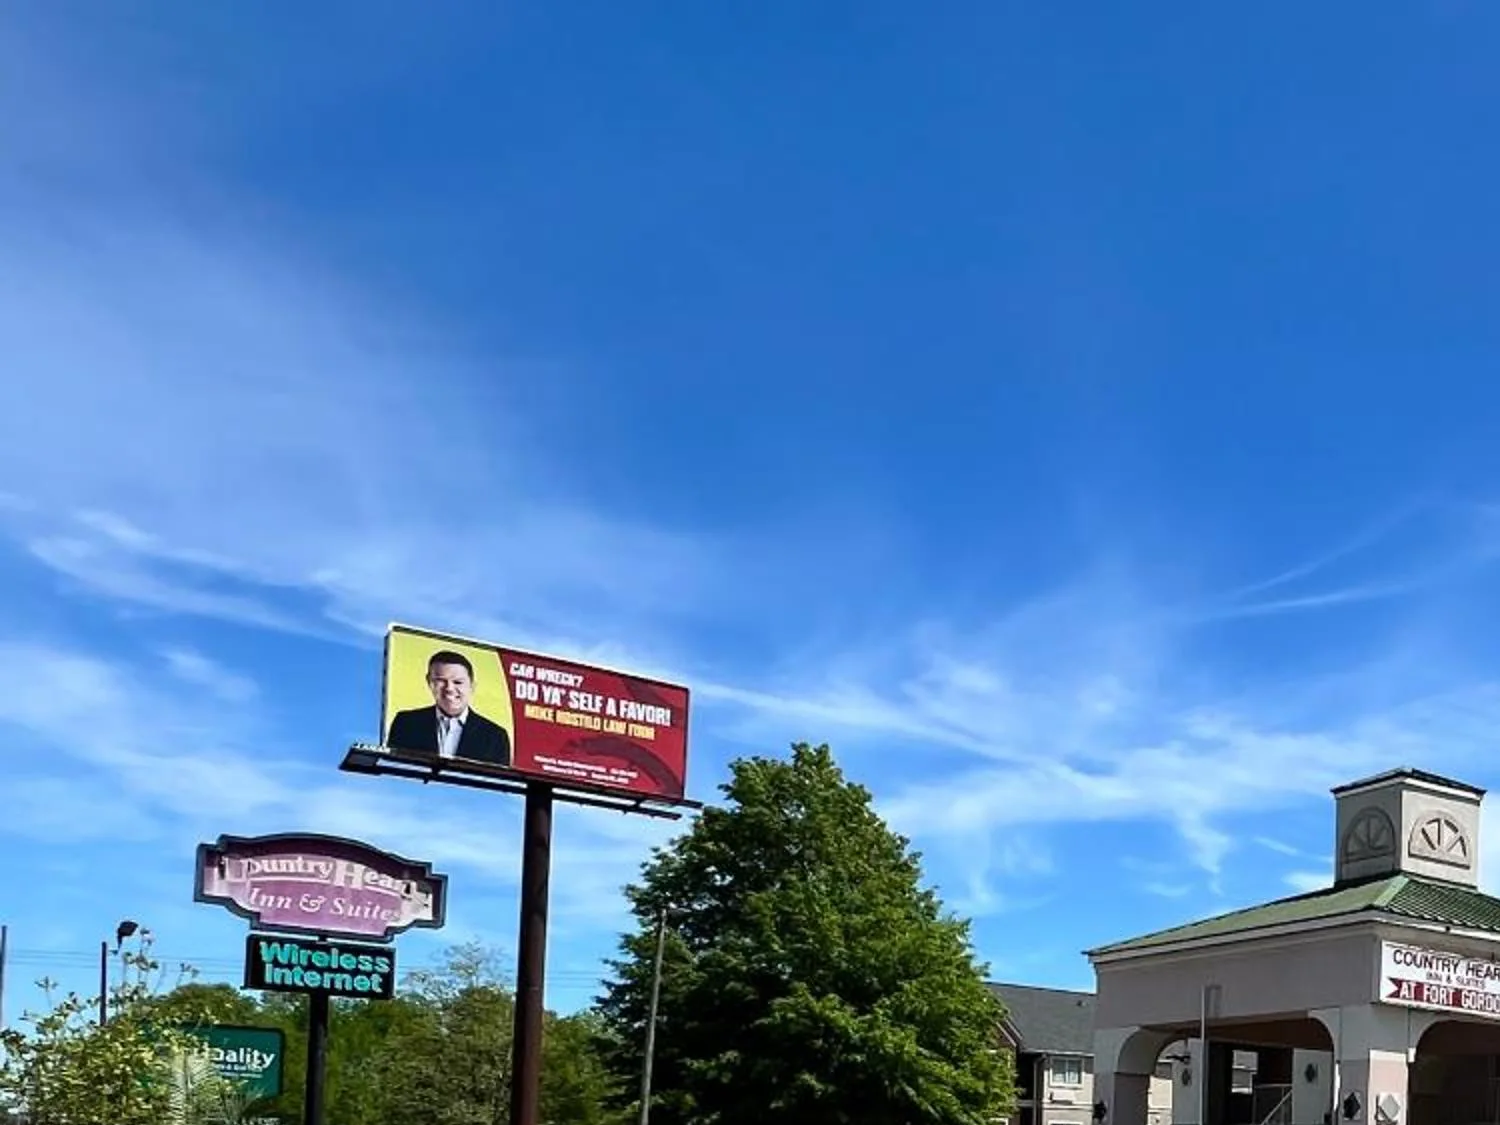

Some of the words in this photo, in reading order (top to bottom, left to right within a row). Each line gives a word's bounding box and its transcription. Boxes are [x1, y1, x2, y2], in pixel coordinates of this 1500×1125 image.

[509, 662, 535, 679] CAR
[536, 667, 585, 687] WRECK?
[515, 680, 539, 701] DO
[567, 690, 603, 713] SELF
[605, 698, 617, 716] A
[619, 700, 671, 726] FAVOR!
[250, 887, 292, 909] Inn
[299, 894, 326, 913] &
[329, 897, 401, 922] Suites
[259, 940, 391, 974] Wireless
[1393, 949, 1460, 974] COUNTRY
[264, 963, 383, 994] Internet
[1400, 981, 1417, 999] AT
[1423, 985, 1454, 1005] FORT
